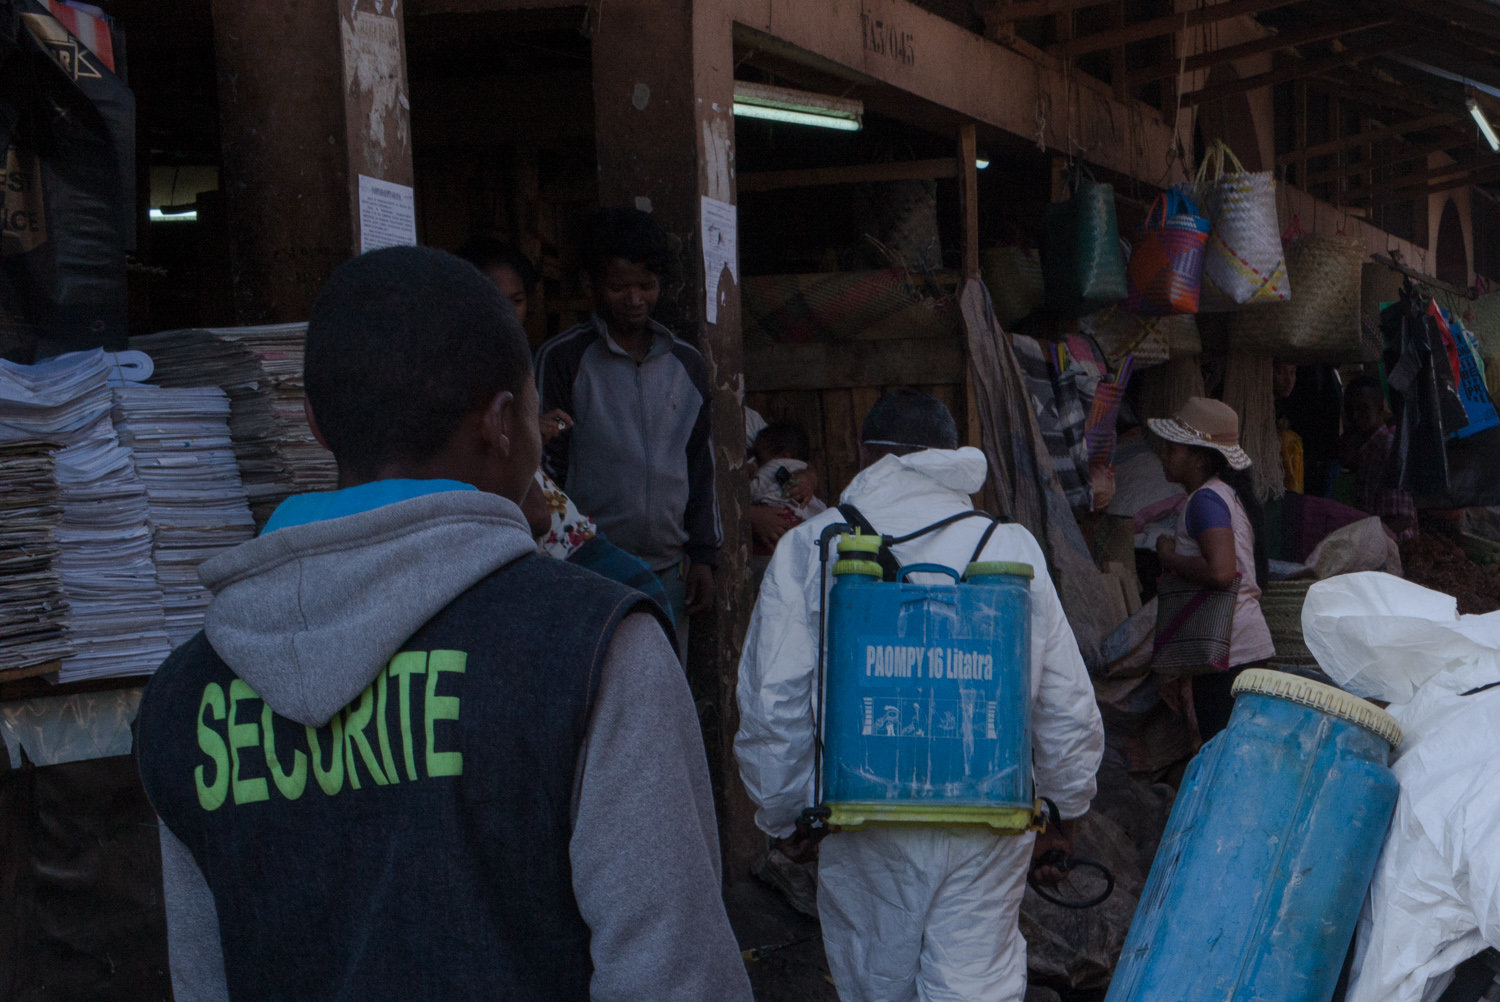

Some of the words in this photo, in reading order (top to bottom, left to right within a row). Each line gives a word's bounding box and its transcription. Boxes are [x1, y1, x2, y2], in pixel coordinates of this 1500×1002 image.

[865, 644, 926, 679] PAOMPY
[927, 646, 944, 680] 16
[946, 646, 993, 681] Litatra
[194, 649, 468, 811] SECURITE
